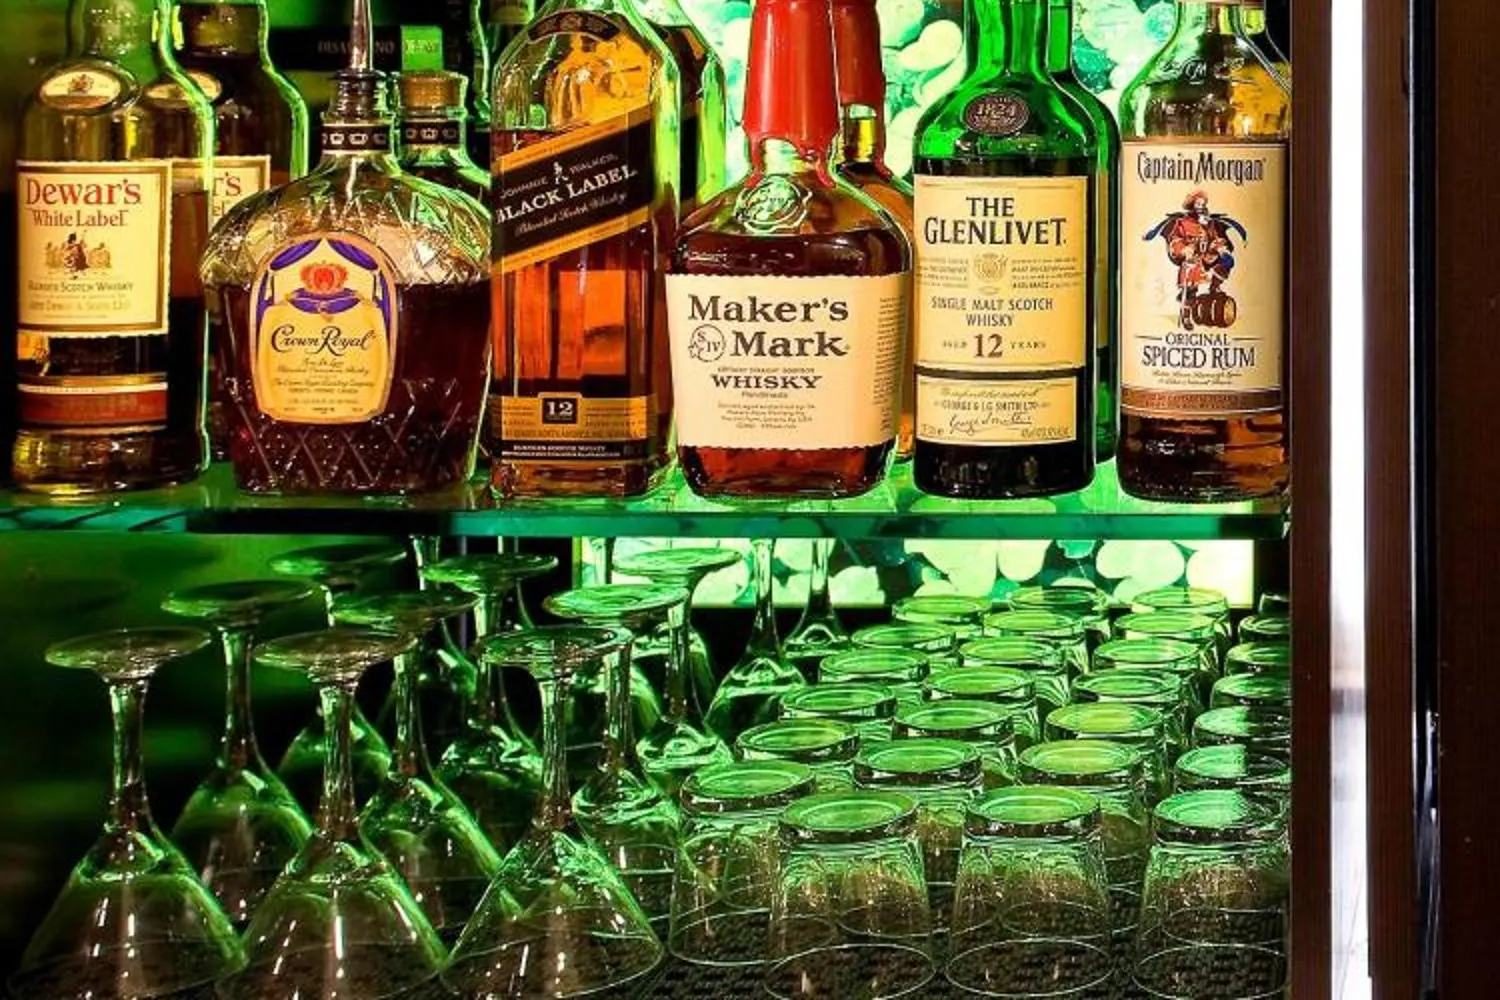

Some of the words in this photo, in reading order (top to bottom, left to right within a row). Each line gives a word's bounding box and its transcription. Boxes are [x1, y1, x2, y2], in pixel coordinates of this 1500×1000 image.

[1137, 151, 1193, 184] Captain
[1195, 152, 1264, 186] Morgan
[26, 178, 141, 205] Dewar's
[497, 188, 564, 224] BLACK
[567, 164, 637, 198] LABEL
[32, 208, 75, 227] White
[76, 208, 127, 228] Label
[966, 196, 1015, 217] THE
[924, 217, 1066, 245] GLENLIVET
[688, 294, 849, 323] Maker's
[931, 296, 967, 311] SINGLE
[972, 298, 1002, 311] MALT
[1008, 297, 1053, 311] SCOTCH
[966, 313, 1015, 327] WHISKY
[271, 323, 320, 354] Crown
[304, 325, 374, 357] Royal
[730, 331, 847, 357] Mark
[973, 333, 1004, 358] 12
[1165, 331, 1231, 347] ORIGINAL
[1142, 345, 1206, 369] SPICED
[1211, 347, 1256, 371] RUM
[710, 374, 823, 390] WHISKY
[547, 401, 574, 416] 12
